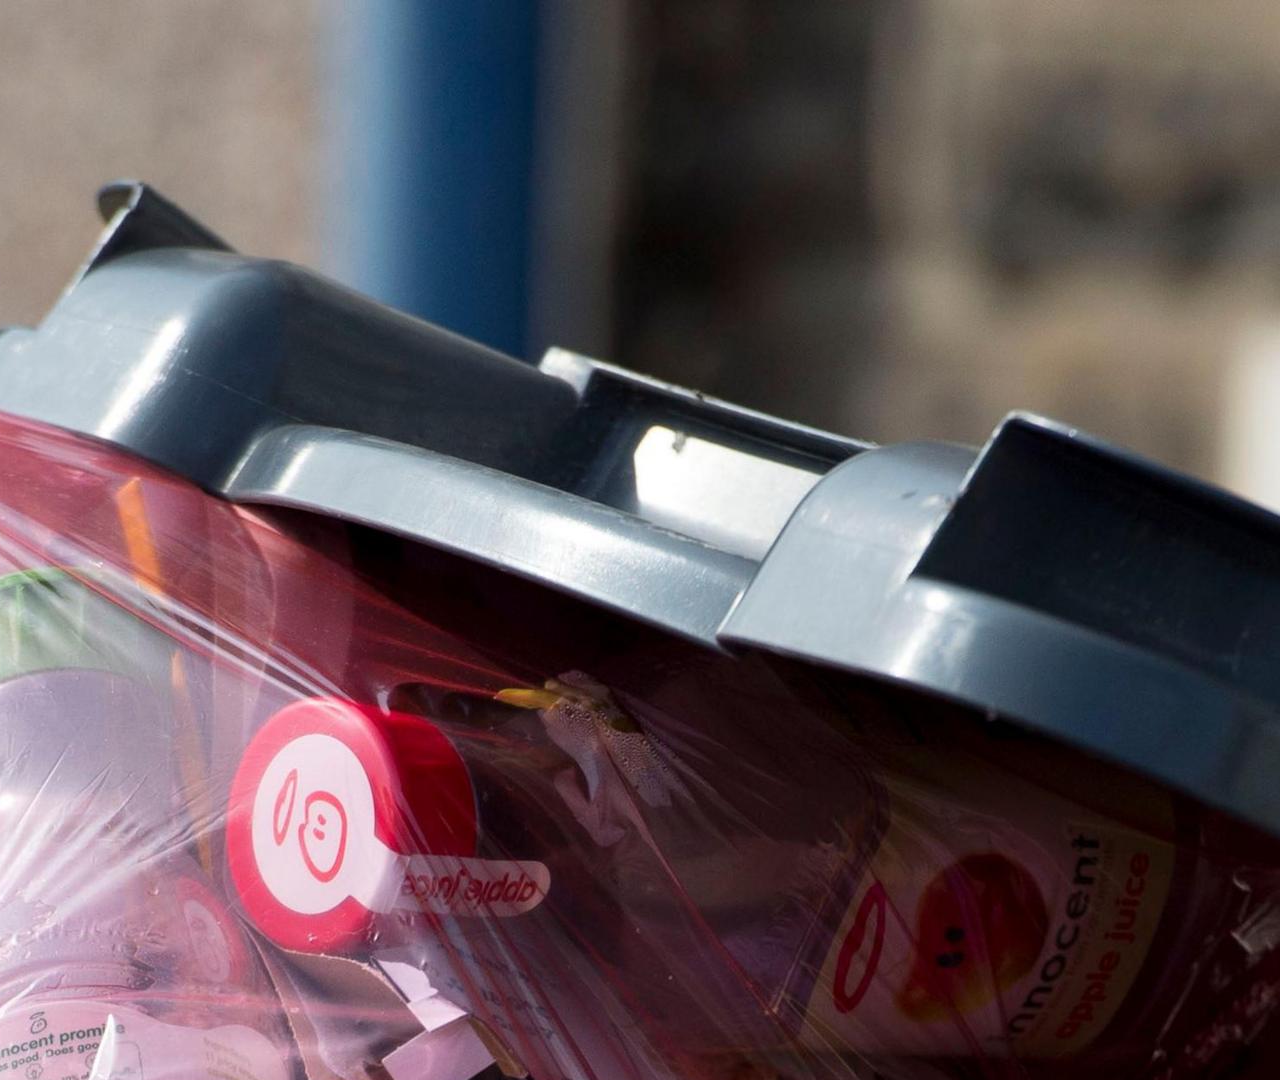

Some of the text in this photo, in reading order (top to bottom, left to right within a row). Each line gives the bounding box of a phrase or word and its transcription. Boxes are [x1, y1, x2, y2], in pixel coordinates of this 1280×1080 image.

[401, 868, 537, 906] apple juice
[1006, 834, 1100, 1035] nnocent
[1055, 951, 1120, 1039] apple
[1104, 852, 1149, 944] juice
[45, 1046, 75, 1058] Does
[77, 1040, 100, 1054] goo
[60, 1023, 125, 1045] promie
